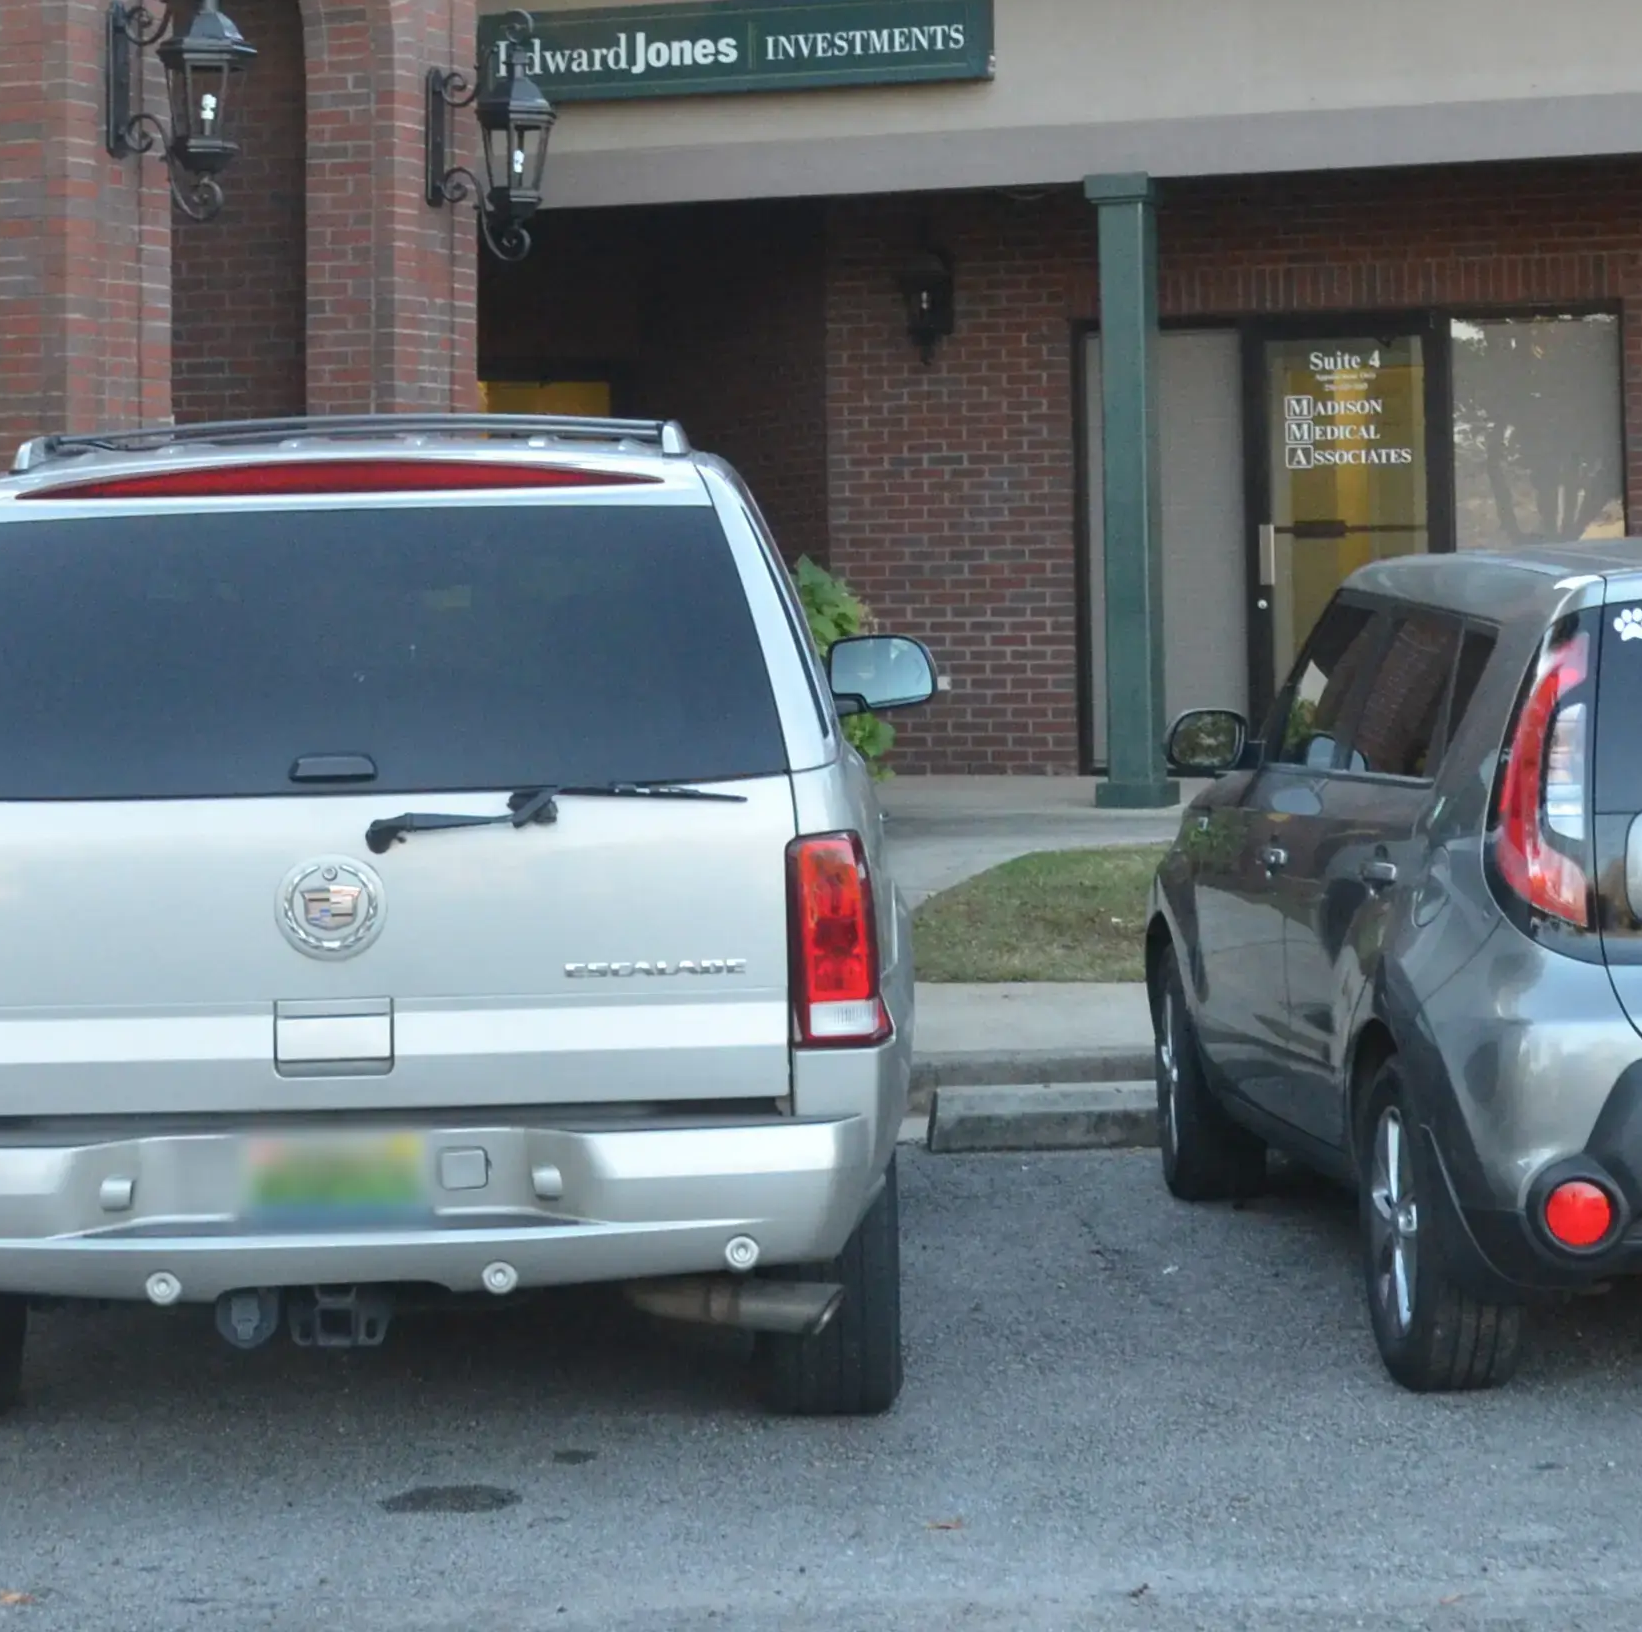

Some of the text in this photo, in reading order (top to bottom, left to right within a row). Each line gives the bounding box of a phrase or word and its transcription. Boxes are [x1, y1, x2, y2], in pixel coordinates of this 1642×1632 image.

[765, 24, 965, 61] INVESTMENTS
[1309, 349, 1381, 371] Suite 4
[1288, 398, 1383, 417] MADISON
[1288, 423, 1381, 441] MEDICAL
[1291, 448, 1412, 466] ASSOCIATES
[564, 958, 747, 979] ESCALADE
